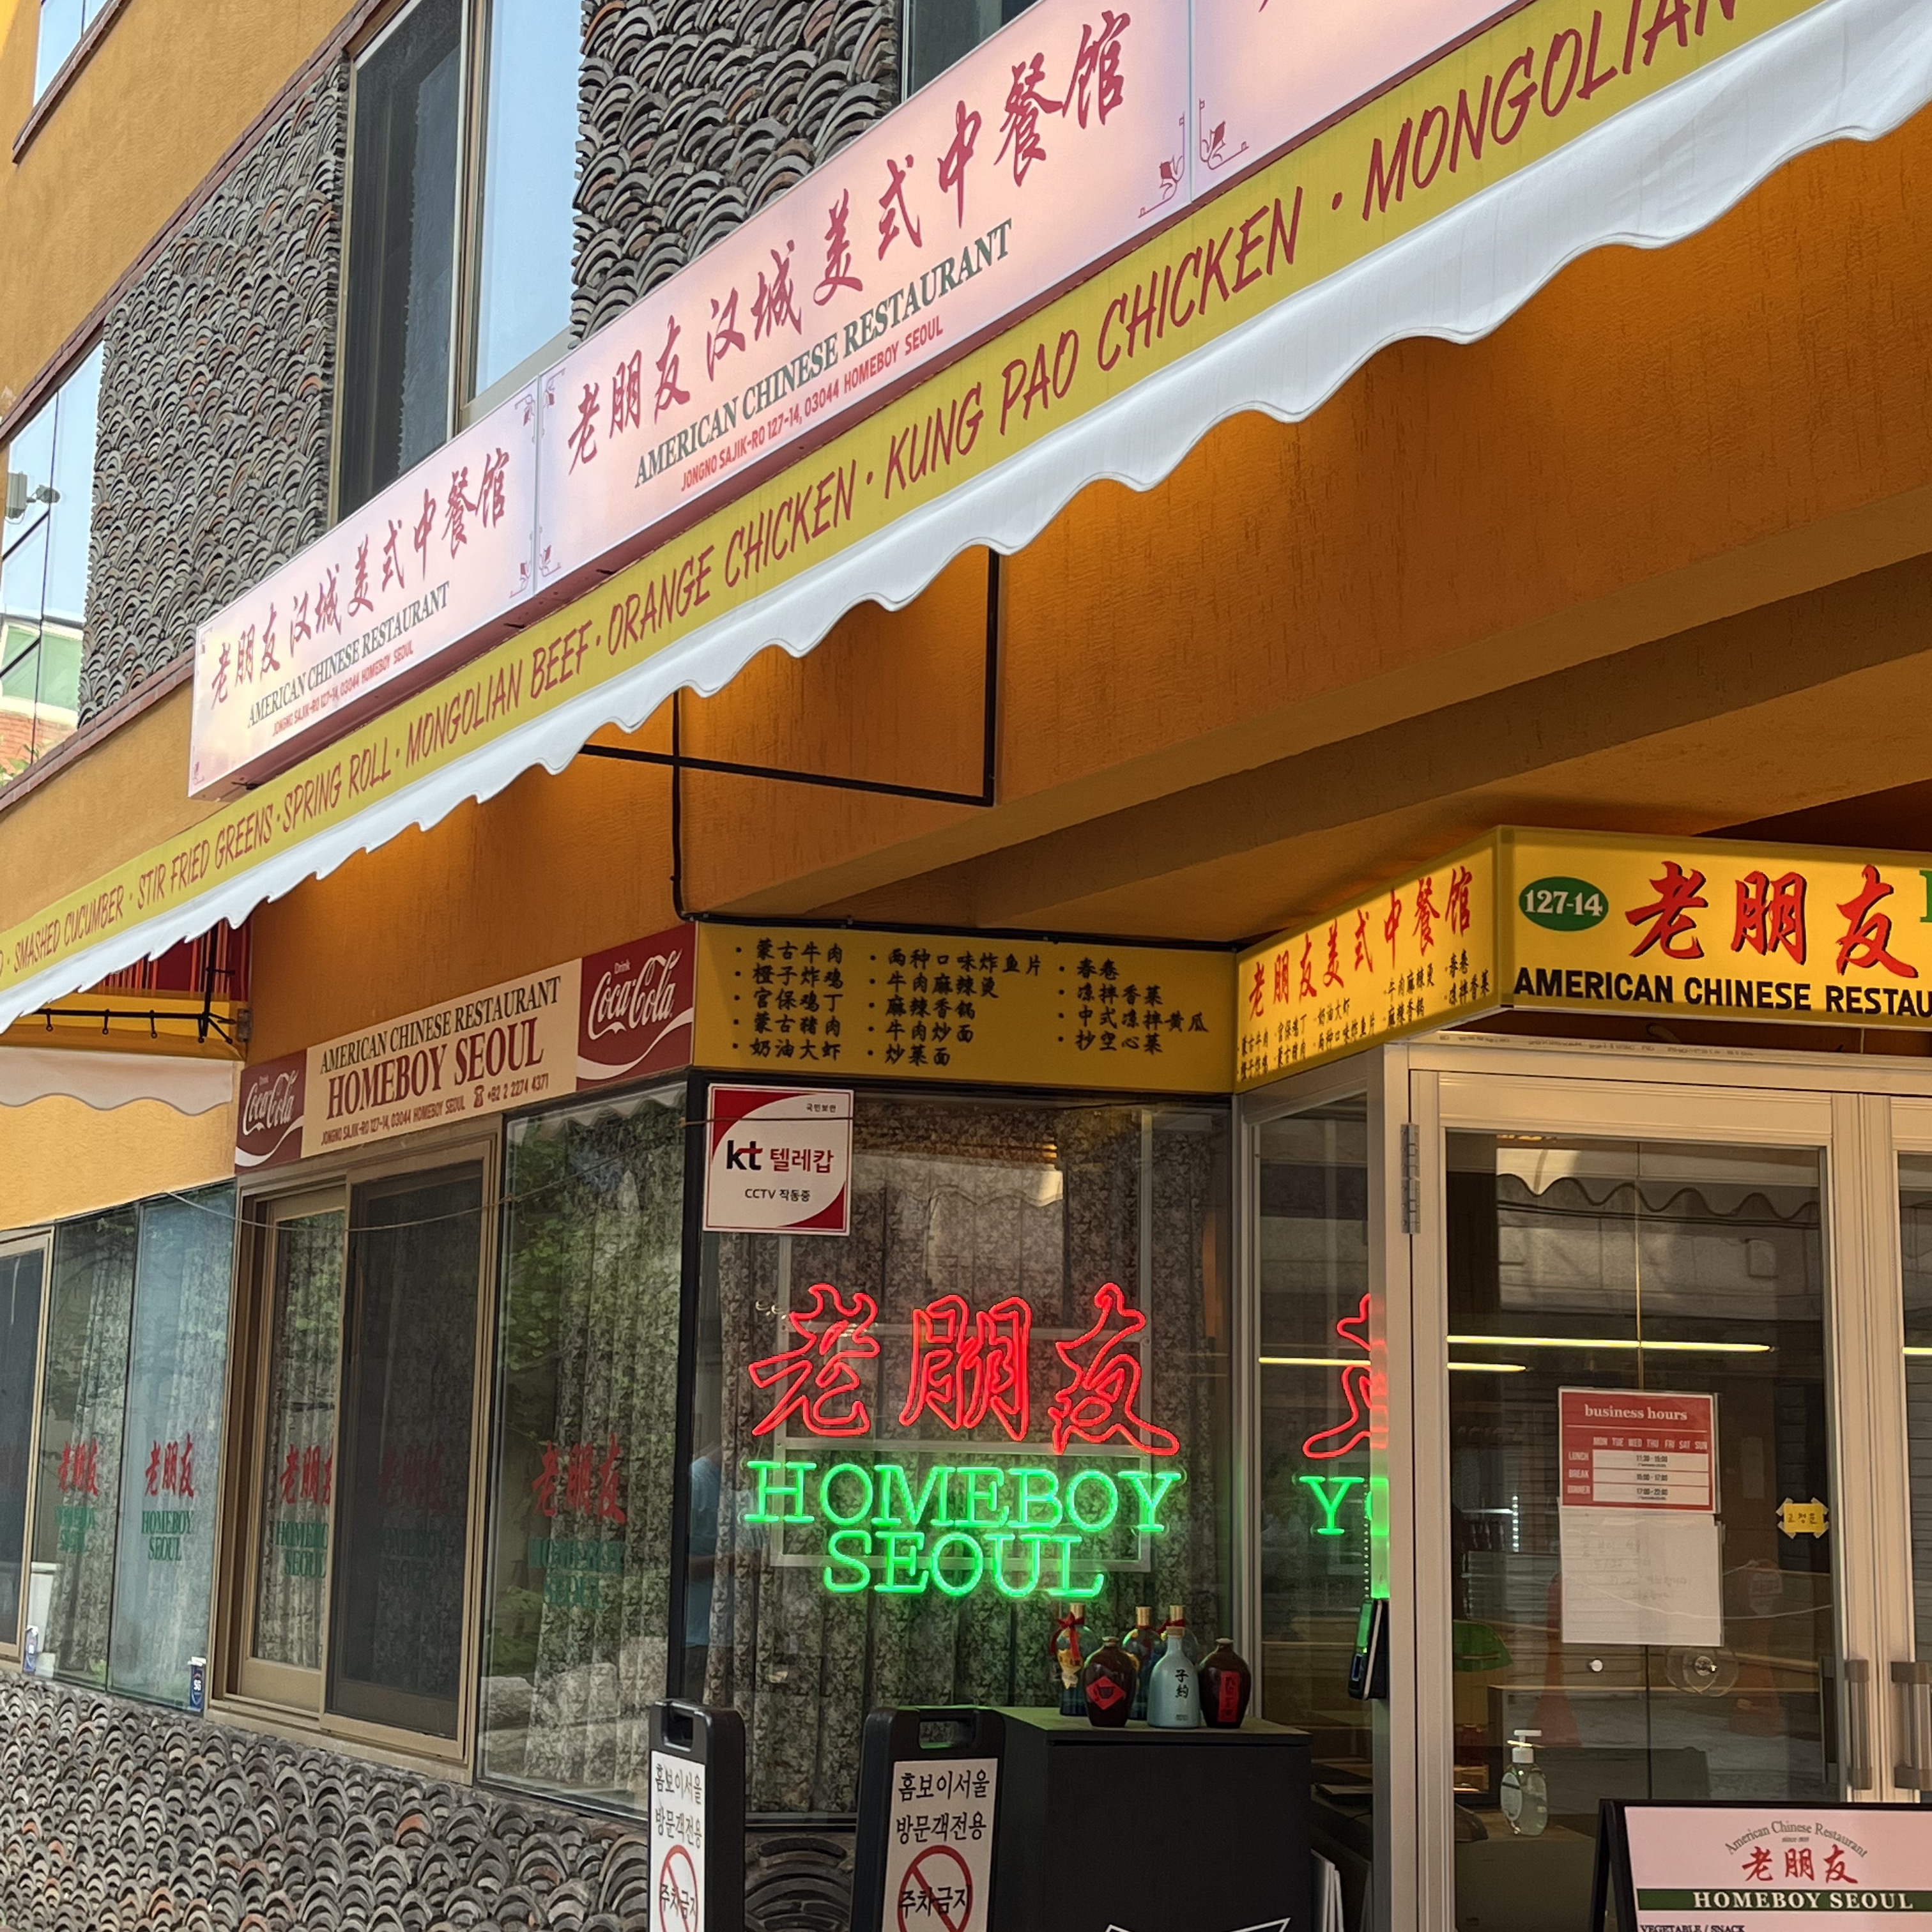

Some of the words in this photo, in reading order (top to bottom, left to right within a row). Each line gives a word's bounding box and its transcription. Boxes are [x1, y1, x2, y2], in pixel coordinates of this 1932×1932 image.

[568, 10, 1130, 477] 老朋友汉城美式中餐馆
[635, 395, 738, 489] AMERICAN
[742, 332, 839, 418] CHINESE
[843, 220, 1013, 354] RESTAURANT
[681, 457, 719, 491] JONGNO
[719, 429, 765, 475] SAJIK-RO
[767, 402, 802, 447] 127-14,
[804, 385, 839, 418] 03044
[843, 349, 900, 402] HOMEBOY
[903, 321, 944, 361] SEOUL
[14, 919, 61, 974] SMASHED
[64, 885, 124, 947] CUCUMBER
[137, 864, 166, 910] STIR
[170, 839, 210, 895] FRIED
[215, 803, 273, 869] GREENS
[282, 763, 342, 832] SPRING
[348, 737, 391, 801] ROLL
[406, 659, 523, 768] MONGOLIAN
[531, 620, 593, 699] BEEF
[608, 545, 712, 656] ORANGE
[724, 459, 857, 588] CHICKEN
[884, 382, 985, 500] KUNG
[999, 328, 1080, 435] PAO
[1098, 187, 1303, 372] CHICKEN
[211, 448, 509, 710] 老朋友汉城美式中餐馆
[248, 675, 306, 728] AMERICAN
[308, 645, 360, 693] CHINESE
[362, 581, 449, 662] RESTAURANT
[1524, 889, 1603, 917] 127-14
[1625, 860, 1919, 979] 老朋友
[756, 937, 843, 964] 蒙古牛肉
[1249, 866, 1472, 1020] 老朋友美式中餐馆
[753, 962, 843, 989] 橙子炸鸡
[887, 970, 999, 999] 牛肉麻辣烫
[1514, 967, 1673, 1004] AMERICAN
[1684, 977, 1811, 1011] CHINESE
[588, 949, 682, 1041] Coca-Cola
[885, 994, 976, 1020] 麻辣香锅
[319, 1032, 387, 1075] AMERICAN
[390, 1009, 451, 1052] CHINESE
[454, 976, 561, 1035] RESTAURANT
[886, 1019, 974, 1043] 牛肉炒面
[749, 1038, 841, 1061] 奶油大虾
[885, 1043, 950, 1066] 炒菜面
[326, 1045, 447, 1121] HOMEBOY
[454, 1017, 544, 1086] SEOUL
[726, 1140, 763, 1170] kt
[770, 1147, 834, 1173] 텔레캅
[745, 1188, 776, 1199] CCTV
[779, 1189, 810, 1202] 작동중
[749, 1282, 1180, 1456] 老朋友
[1584, 1404, 1644, 1419] business
[1647, 1406, 1687, 1422] hours
[1612, 1438, 1624, 1447] TUE
[1646, 1439, 1659, 1448] THU
[1679, 1440, 1690, 1450] SAT
[144, 1433, 194, 1498] 老朋友
[744, 1459, 1183, 1533] HOMEBOY
[141, 1510, 194, 1534] HOMEBOY
[148, 1537, 181, 1561] SEOUL
[824, 1529, 1105, 1598] SEOUL
[656, 1763, 702, 1805] 홈보이서울
[898, 1768, 990, 1802] 홈보이서울
[655, 1807, 703, 1850] 방문객전용
[896, 1811, 987, 1844] 방문객전용
[1725, 1825, 1770, 1855] American
[1771, 1820, 1813, 1834] Chinese
[1814, 1822, 1867, 1858] Restaurant
[1742, 1844, 1858, 1883] 老朋友
[660, 1883, 698, 1919] 주차금지
[898, 1884, 972, 1919] 주차금지
[1693, 1891, 1821, 1909] HOMEBOY
[1830, 1892, 1913, 1909] SEOUL
